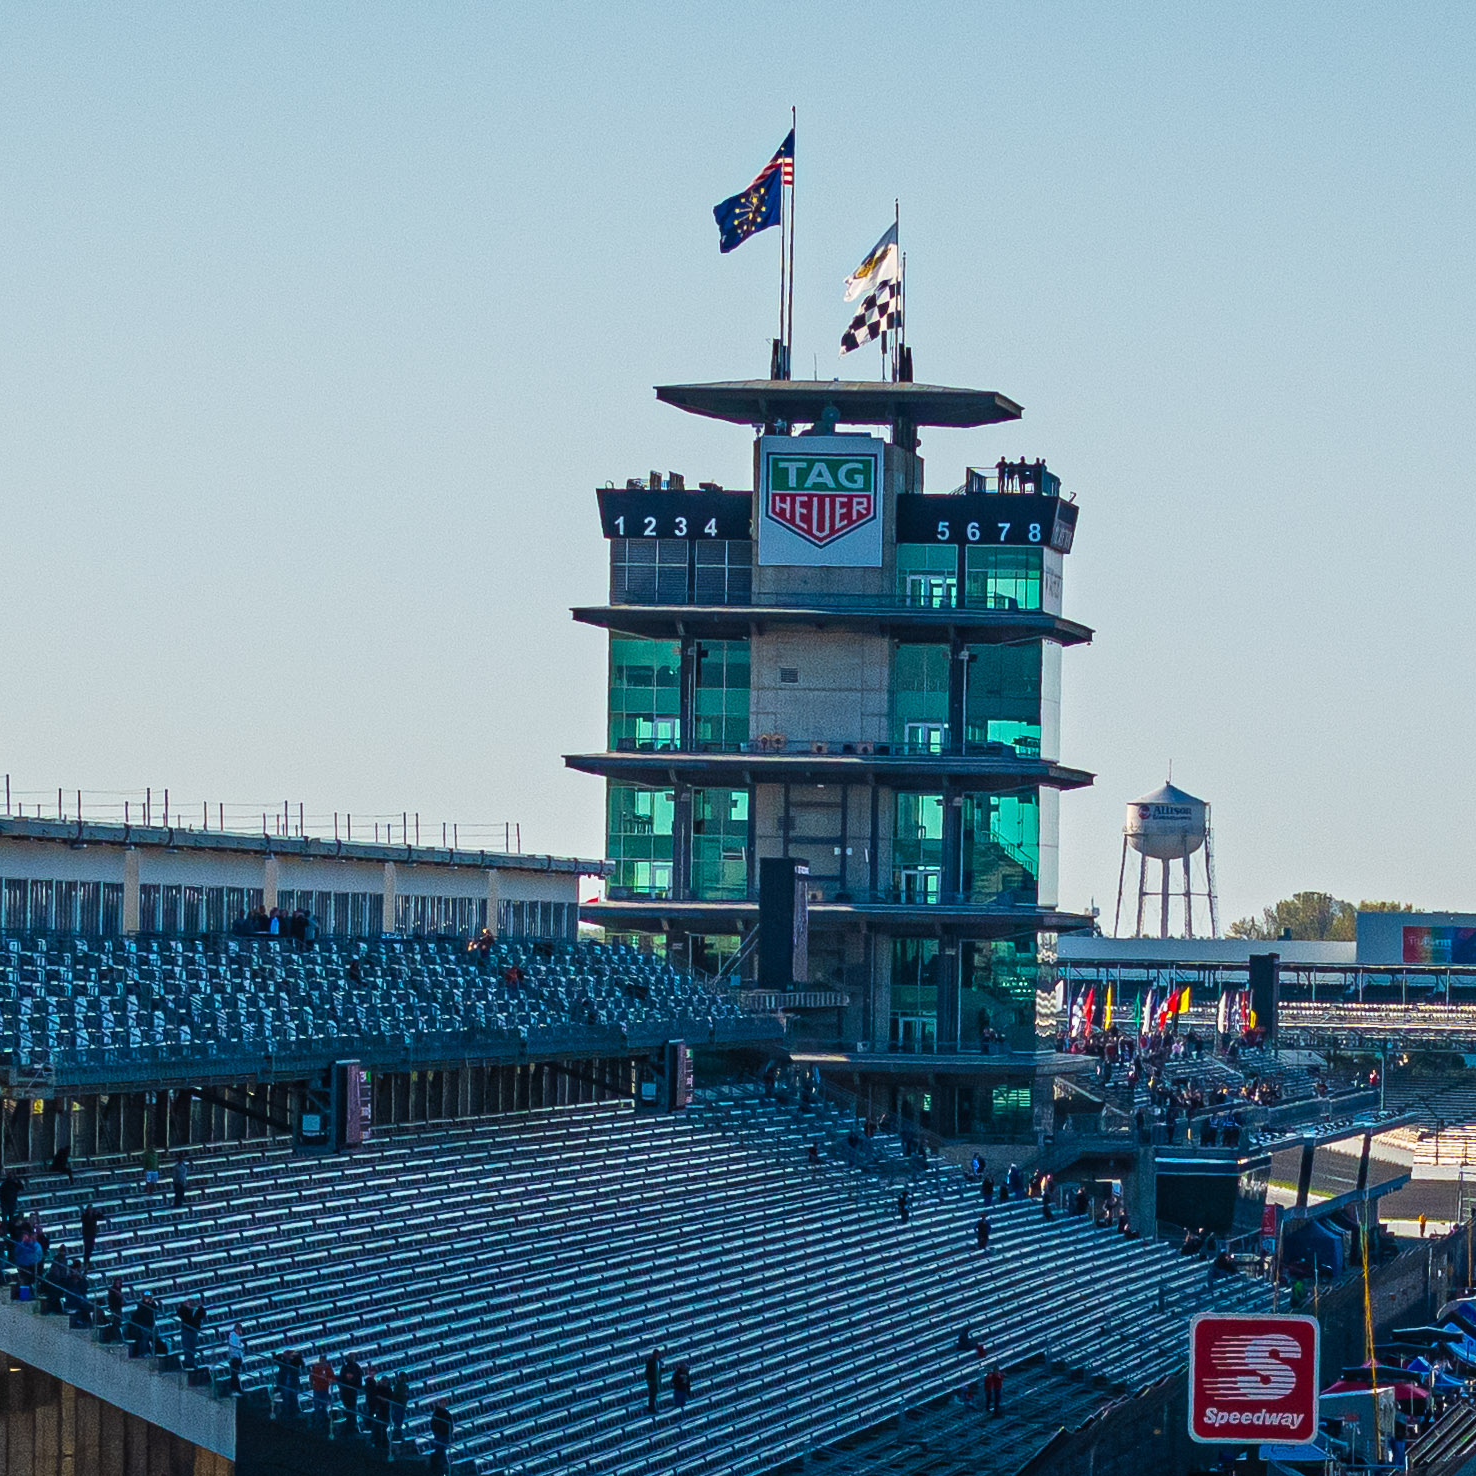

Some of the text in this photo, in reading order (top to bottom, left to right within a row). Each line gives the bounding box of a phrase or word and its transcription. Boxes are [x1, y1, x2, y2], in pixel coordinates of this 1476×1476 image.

[778, 462, 864, 489] TAG
[614, 516, 718, 537] 1 2 3 4
[775, 496, 868, 538] HEUER
[937, 522, 950, 541] 5
[967, 522, 980, 541] 6
[998, 523, 1011, 541] 7
[1028, 523, 1041, 542] 8
[1203, 1407, 1304, 1429] Speedway
